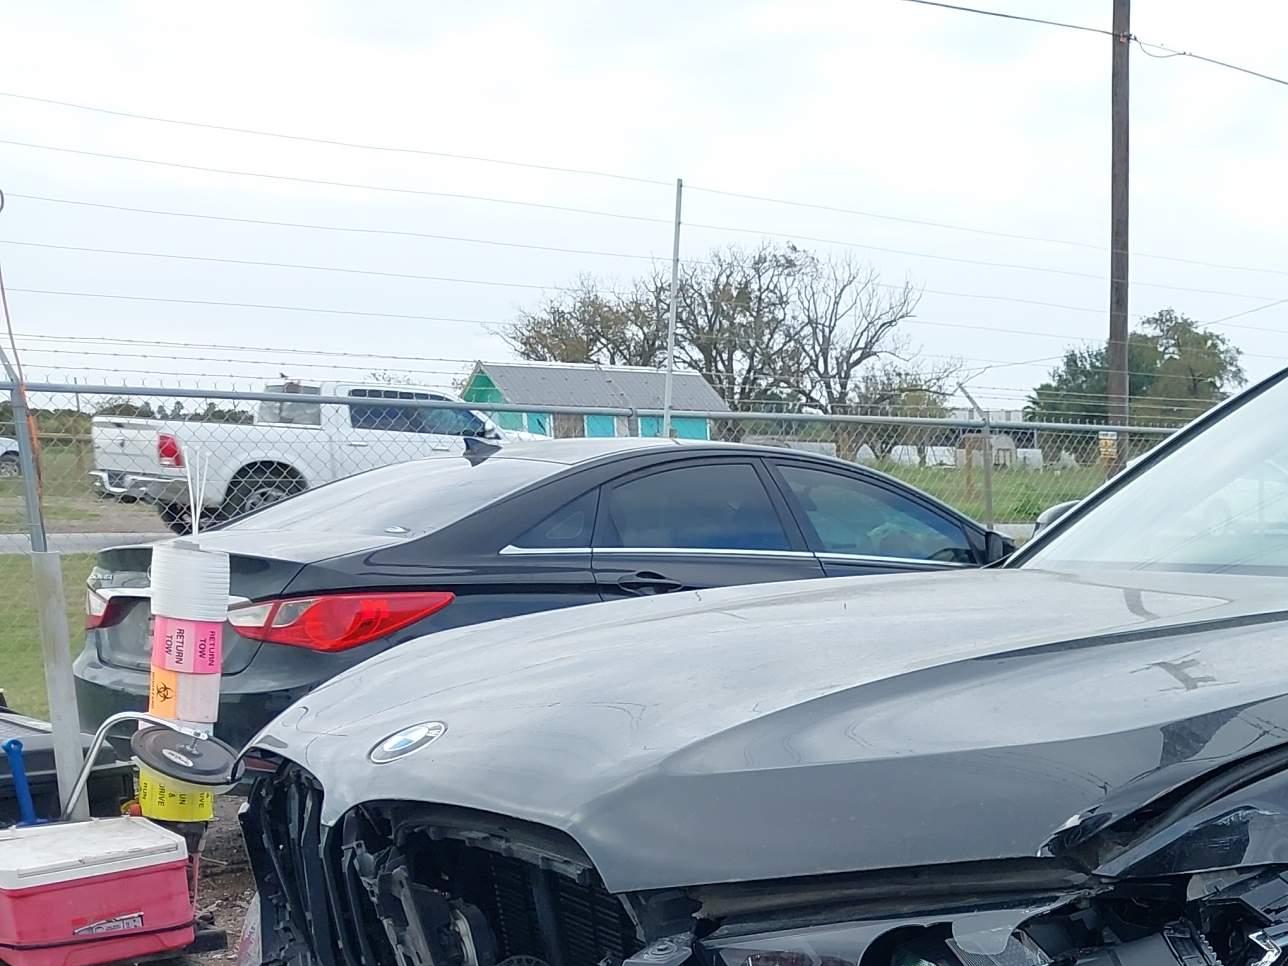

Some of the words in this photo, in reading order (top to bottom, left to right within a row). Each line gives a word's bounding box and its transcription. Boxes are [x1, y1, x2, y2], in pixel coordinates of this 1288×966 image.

[165, 635, 173, 655] TOW
[175, 628, 184, 664] RETURN
[199, 638, 207, 659] TOW
[208, 631, 216, 666] RETURN
